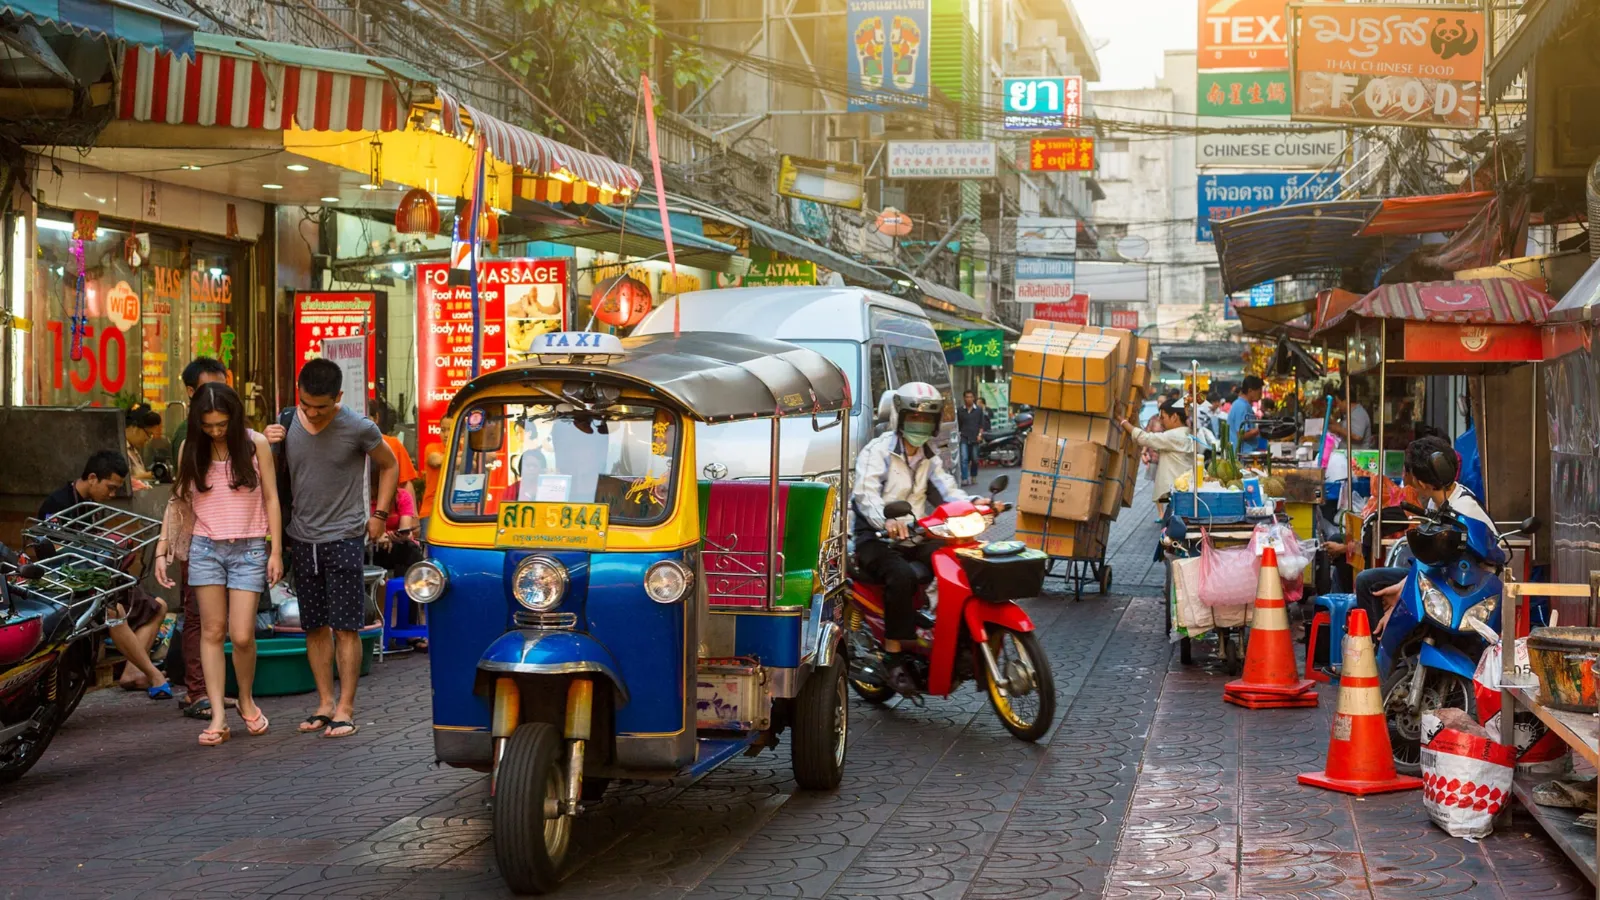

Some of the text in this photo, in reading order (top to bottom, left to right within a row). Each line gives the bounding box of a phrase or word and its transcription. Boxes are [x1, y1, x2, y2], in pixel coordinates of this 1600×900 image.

[1326, 58, 1455, 76] THAI CHINESE FOOD
[1010, 80, 1059, 112] ยา
[1330, 74, 1458, 116] FOOD
[1203, 143, 1337, 157] CHINESE CUISINE
[909, 167, 932, 175] MENG
[1204, 175, 1274, 201] ที่จอดรถ
[765, 263, 800, 277] ATM
[190, 270, 232, 304] SAGE
[431, 289, 452, 300] Foot
[430, 322, 455, 336] Body
[545, 333, 602, 348] TAXI
[964, 338, 1000, 357] 如意
[47, 320, 126, 393] 150
[435, 356, 450, 368] Oil
[504, 504, 602, 530] สก 5844
